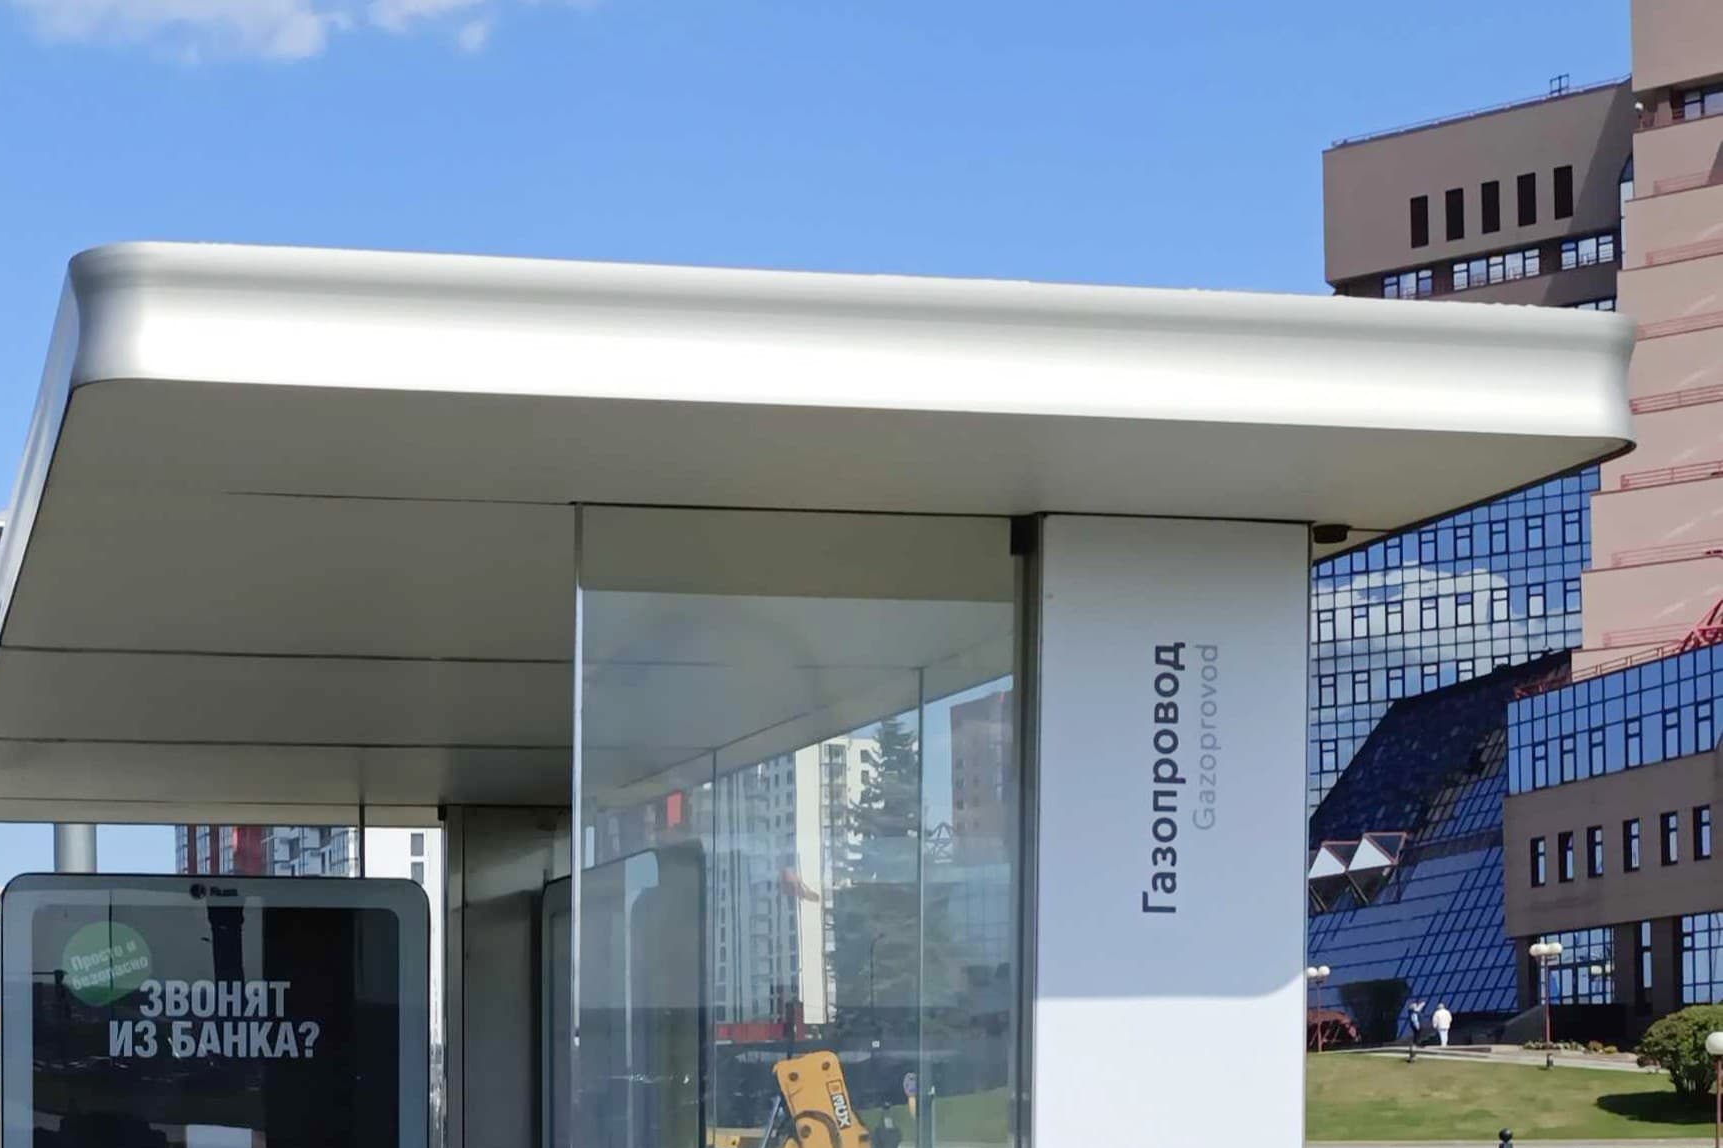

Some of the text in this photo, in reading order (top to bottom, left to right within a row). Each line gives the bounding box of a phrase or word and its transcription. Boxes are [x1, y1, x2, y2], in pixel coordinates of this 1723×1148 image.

[1192, 643, 1221, 831] Gazoprovod
[1142, 641, 1186, 913] Газопровод
[70, 944, 123, 972] Просто
[139, 979, 292, 1018] ЗВОНЯТ
[109, 1020, 320, 1058] ИЗ БАНКА?
